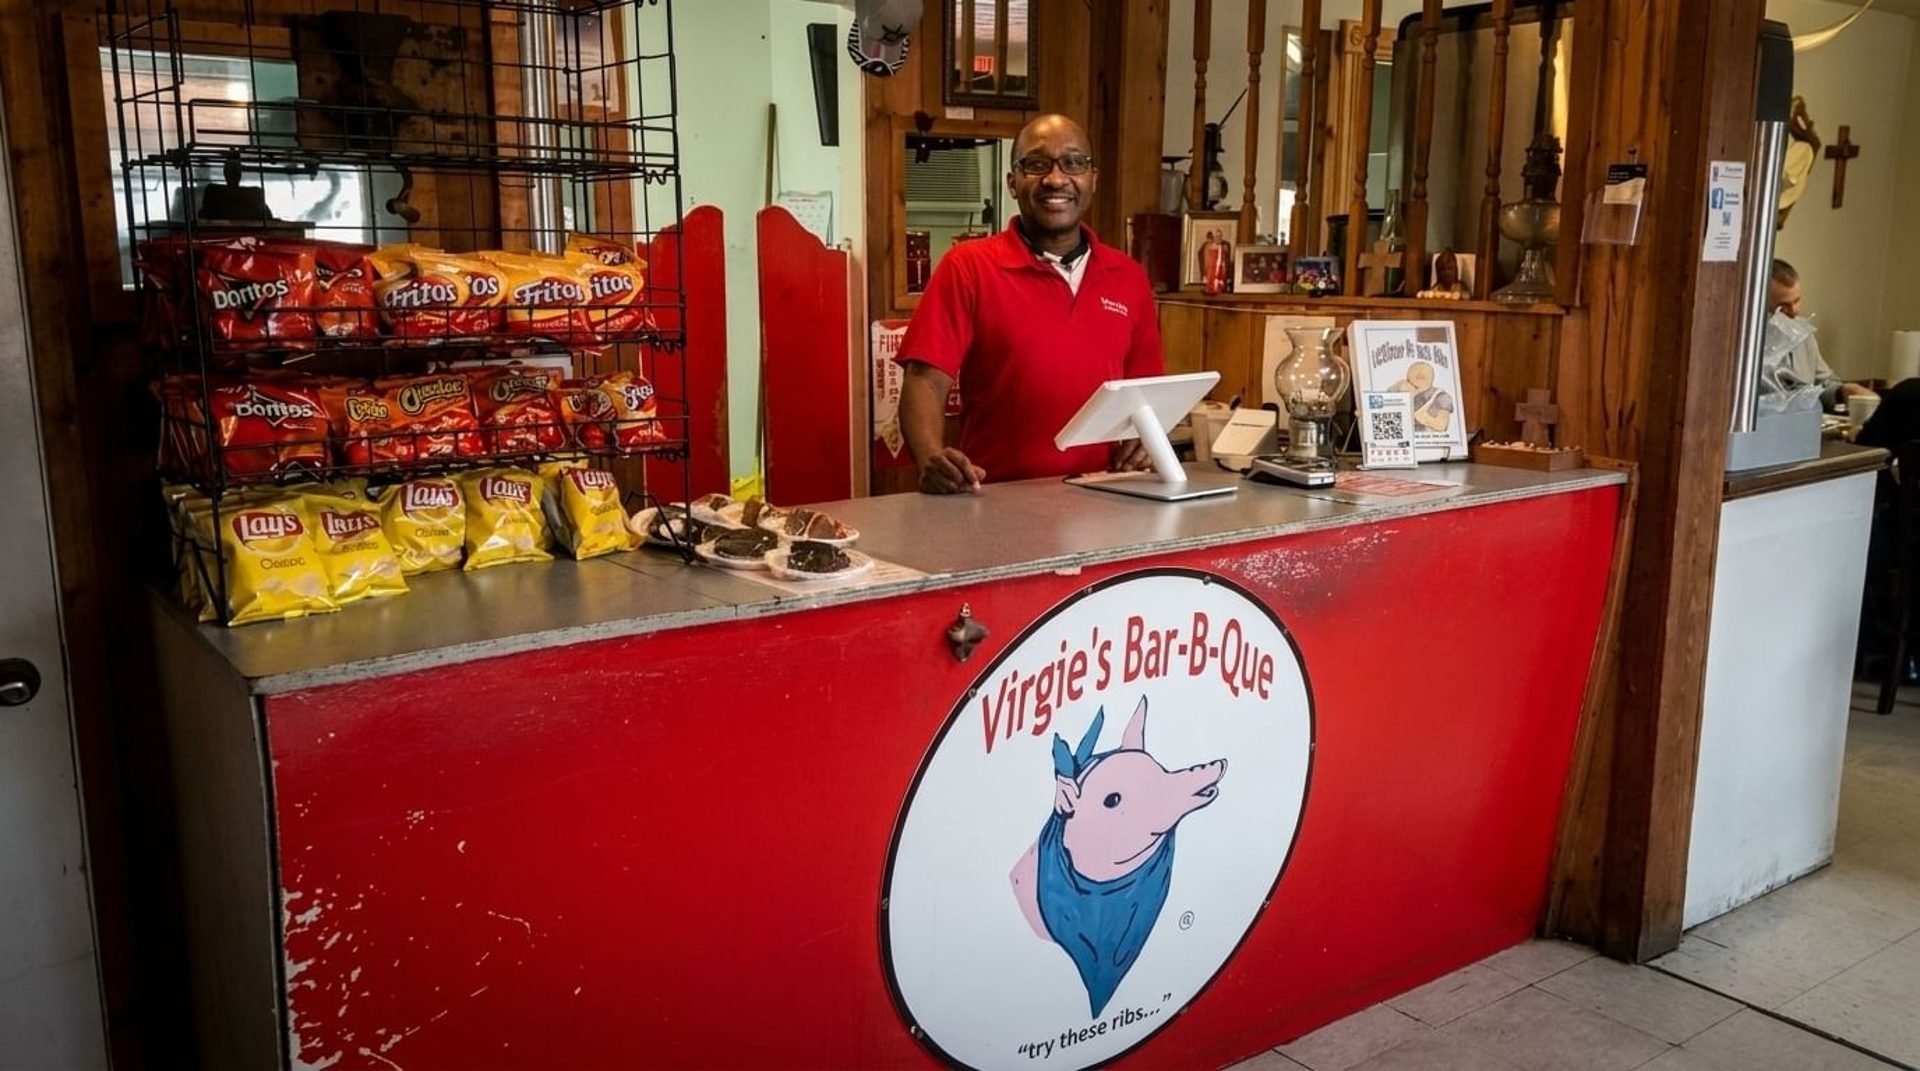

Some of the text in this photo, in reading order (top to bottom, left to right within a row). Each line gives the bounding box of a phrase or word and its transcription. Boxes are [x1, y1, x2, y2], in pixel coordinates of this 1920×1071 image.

[212, 279, 289, 309] Doritos
[981, 611, 1274, 755] Virgie's Bar-B-Que
[1059, 1019, 1108, 1050] these
